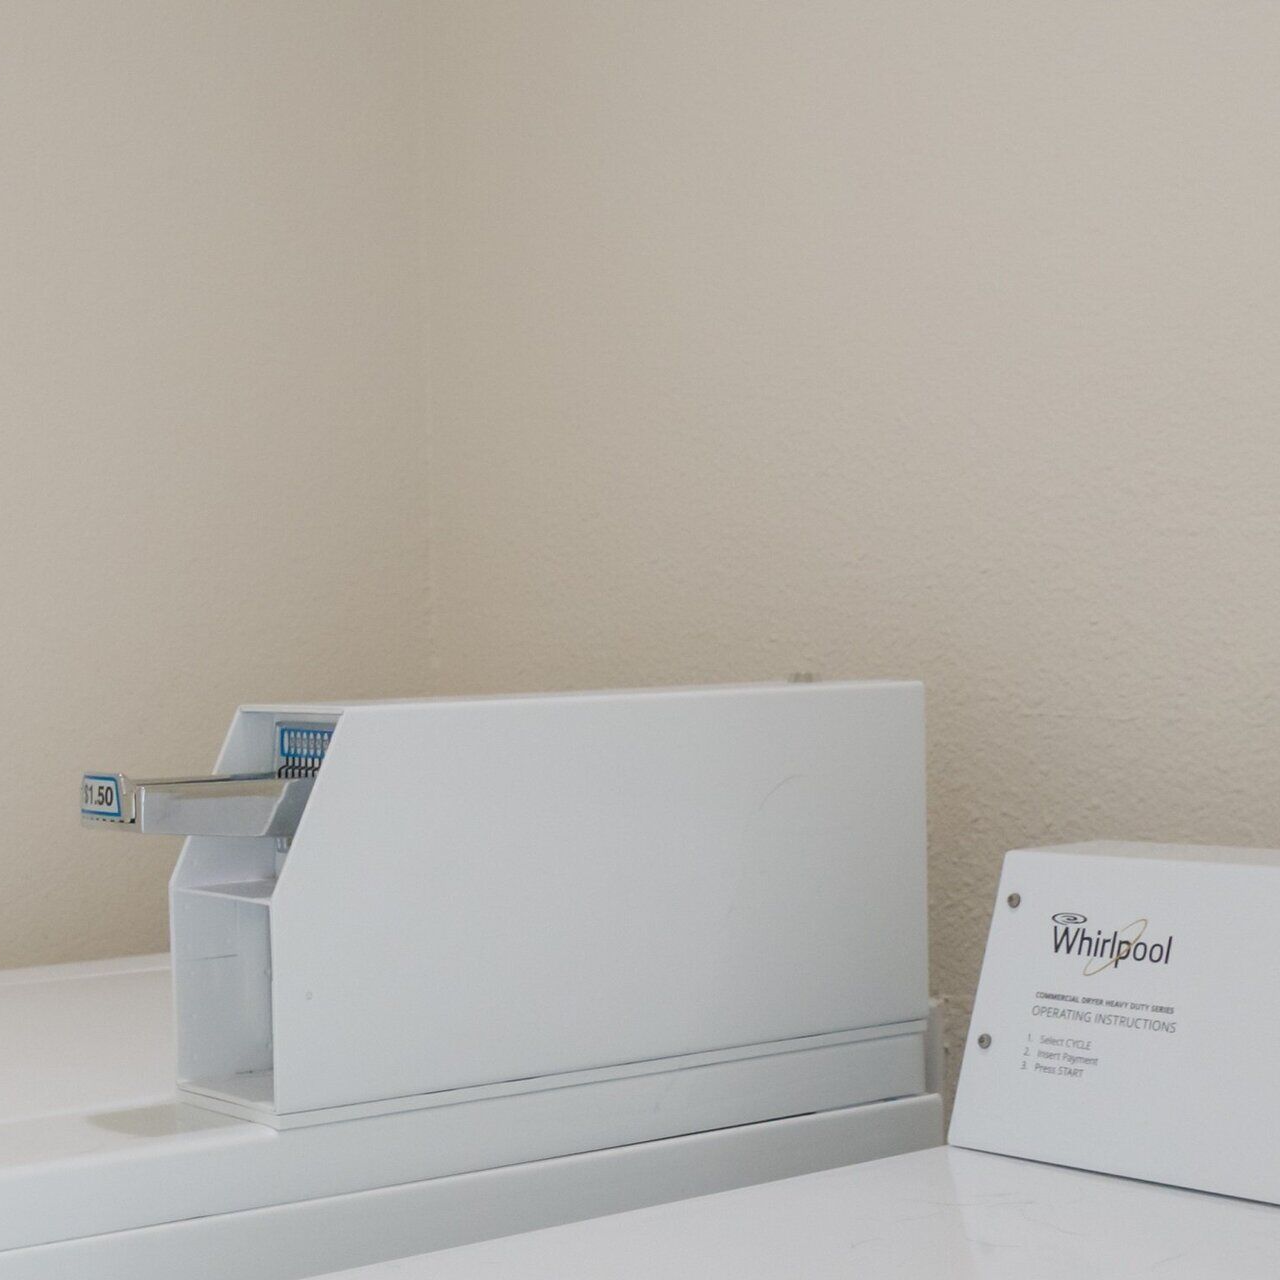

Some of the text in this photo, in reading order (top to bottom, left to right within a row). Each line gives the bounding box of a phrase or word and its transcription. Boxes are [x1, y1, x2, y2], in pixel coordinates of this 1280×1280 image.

[1053, 925, 1173, 968] Whirlpool
[1035, 991, 1175, 1014] COMMERCIAL DRYER HEAVY DUTY SERIES
[1031, 1005, 1177, 1034] OPERATING INSTRUCTIONS
[1040, 1035, 1064, 1047] Select
[1065, 1038, 1092, 1050] CYCLE
[1036, 1049, 1061, 1061] Insert
[1062, 1053, 1099, 1066] Payment
[1034, 1062, 1057, 1074] Press
[1058, 1066, 1084, 1078] START
